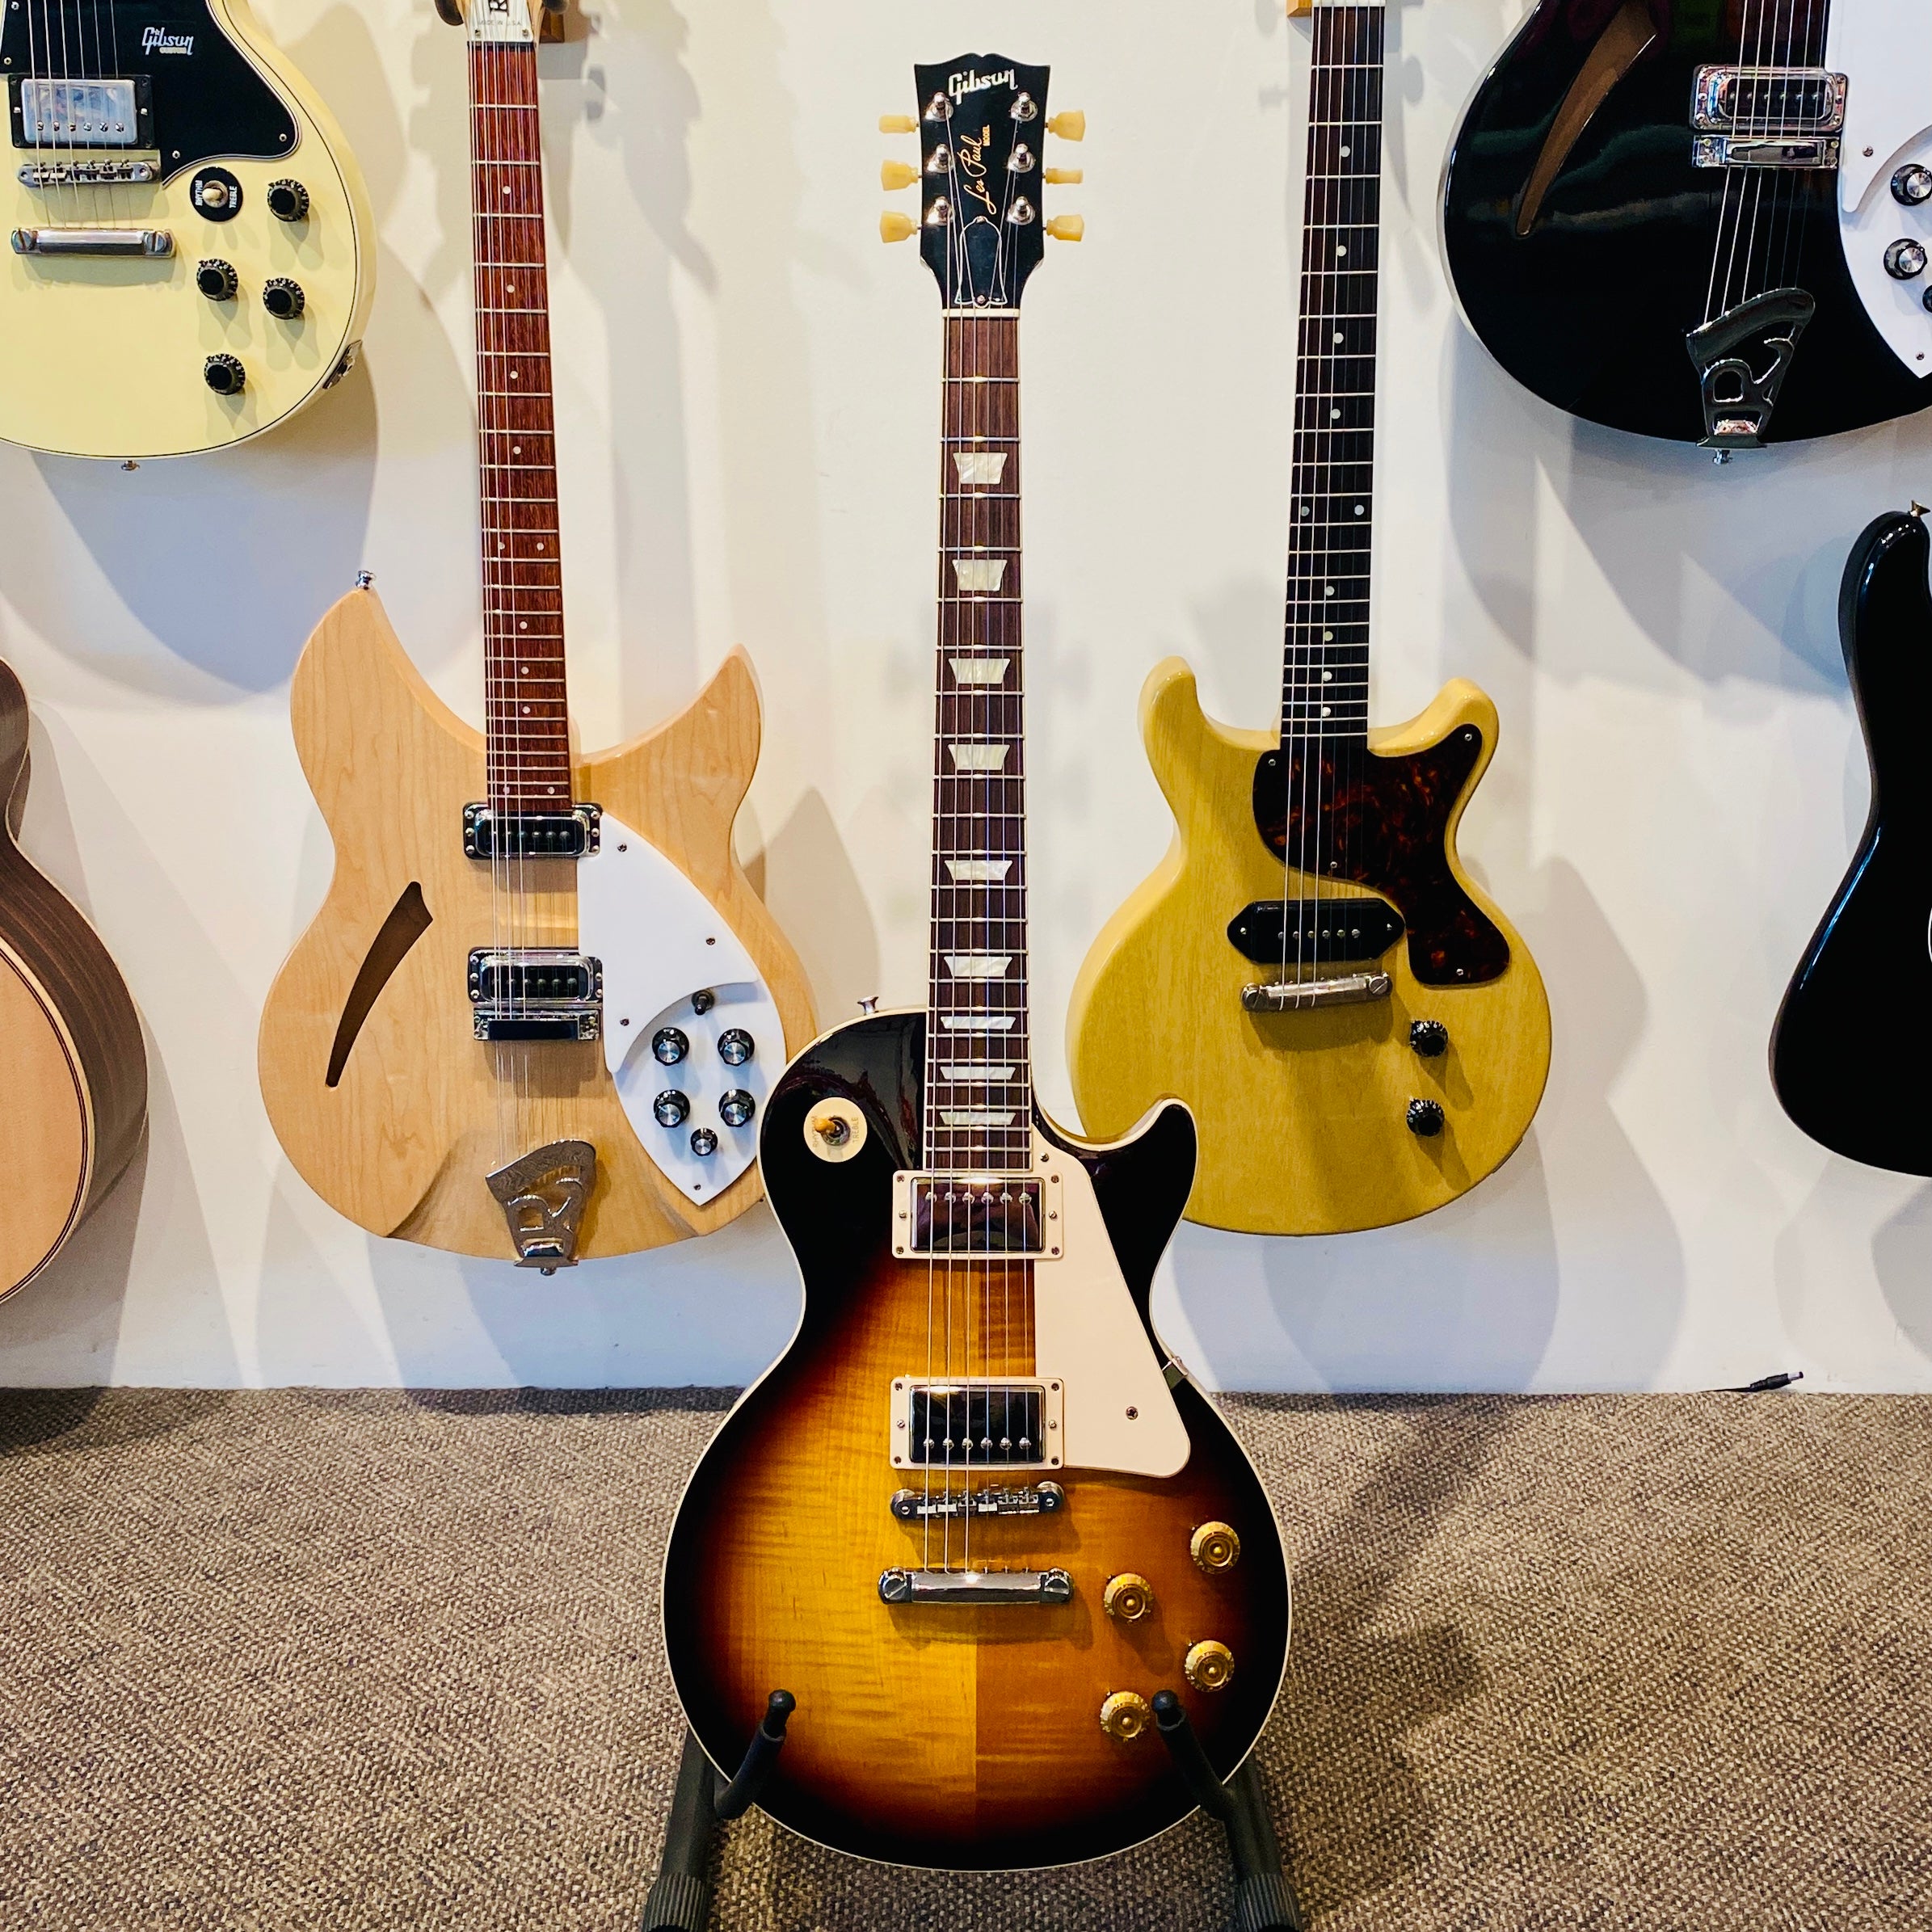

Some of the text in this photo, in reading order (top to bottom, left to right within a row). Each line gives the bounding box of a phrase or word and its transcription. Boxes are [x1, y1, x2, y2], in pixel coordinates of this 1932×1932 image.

[141, 27, 194, 56] Gibson
[948, 69, 1018, 106] Gibson
[957, 134, 997, 215] Les Paul
[229, 185, 238, 208] TREBLE
[851, 1117, 860, 1143] TREBLE
